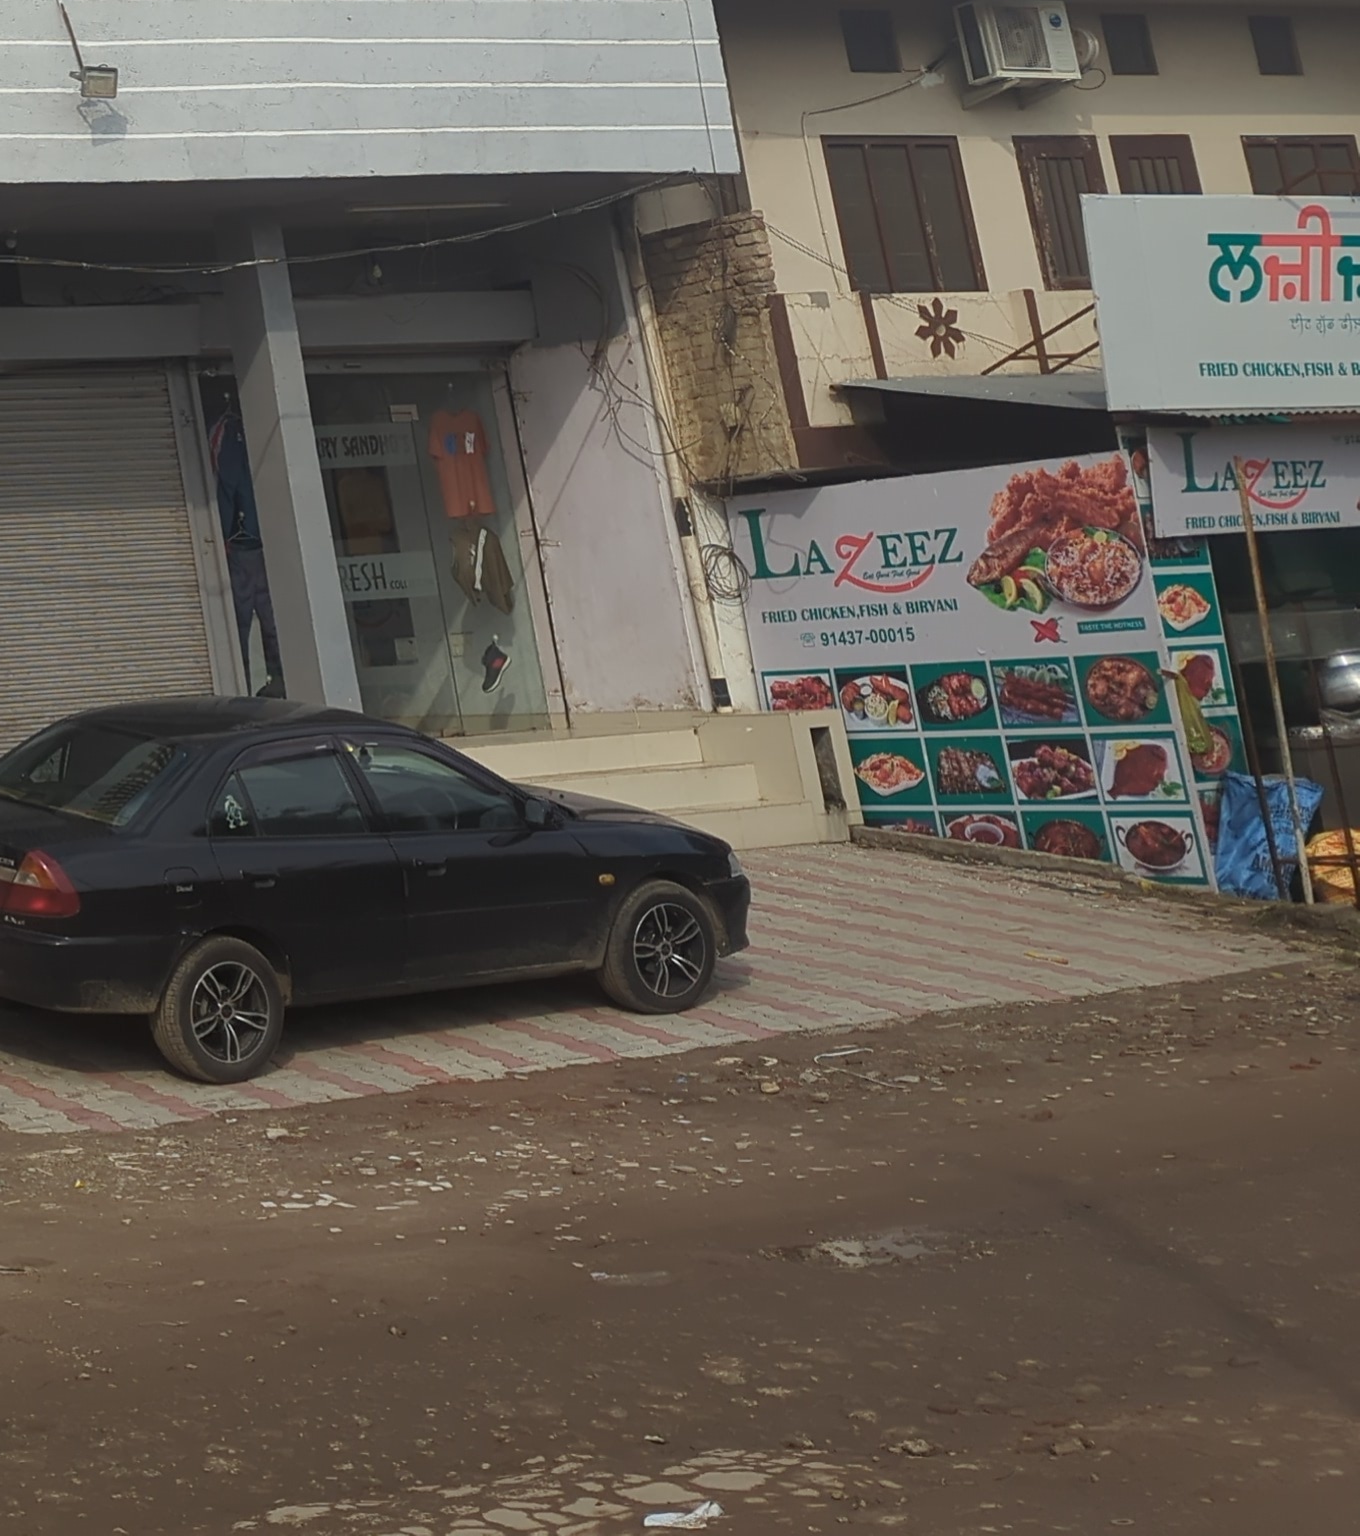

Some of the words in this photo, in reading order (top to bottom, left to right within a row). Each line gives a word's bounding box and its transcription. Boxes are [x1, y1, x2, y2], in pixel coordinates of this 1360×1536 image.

[1199, 362, 1238, 376] FRIED
[1338, 363, 1348, 376] &
[1185, 516, 1216, 529] FRIED
[1218, 512, 1288, 527] CHICEN,FISH
[1291, 514, 1298, 524] &
[1301, 511, 1340, 524] BIRYANI
[738, 508, 964, 594] LAZEEZ
[339, 562, 388, 593] RESH
[762, 609, 797, 624] FRIED
[892, 601, 902, 614] &
[906, 597, 958, 614] BIRYANI
[820, 627, 915, 646] 91437-00015
